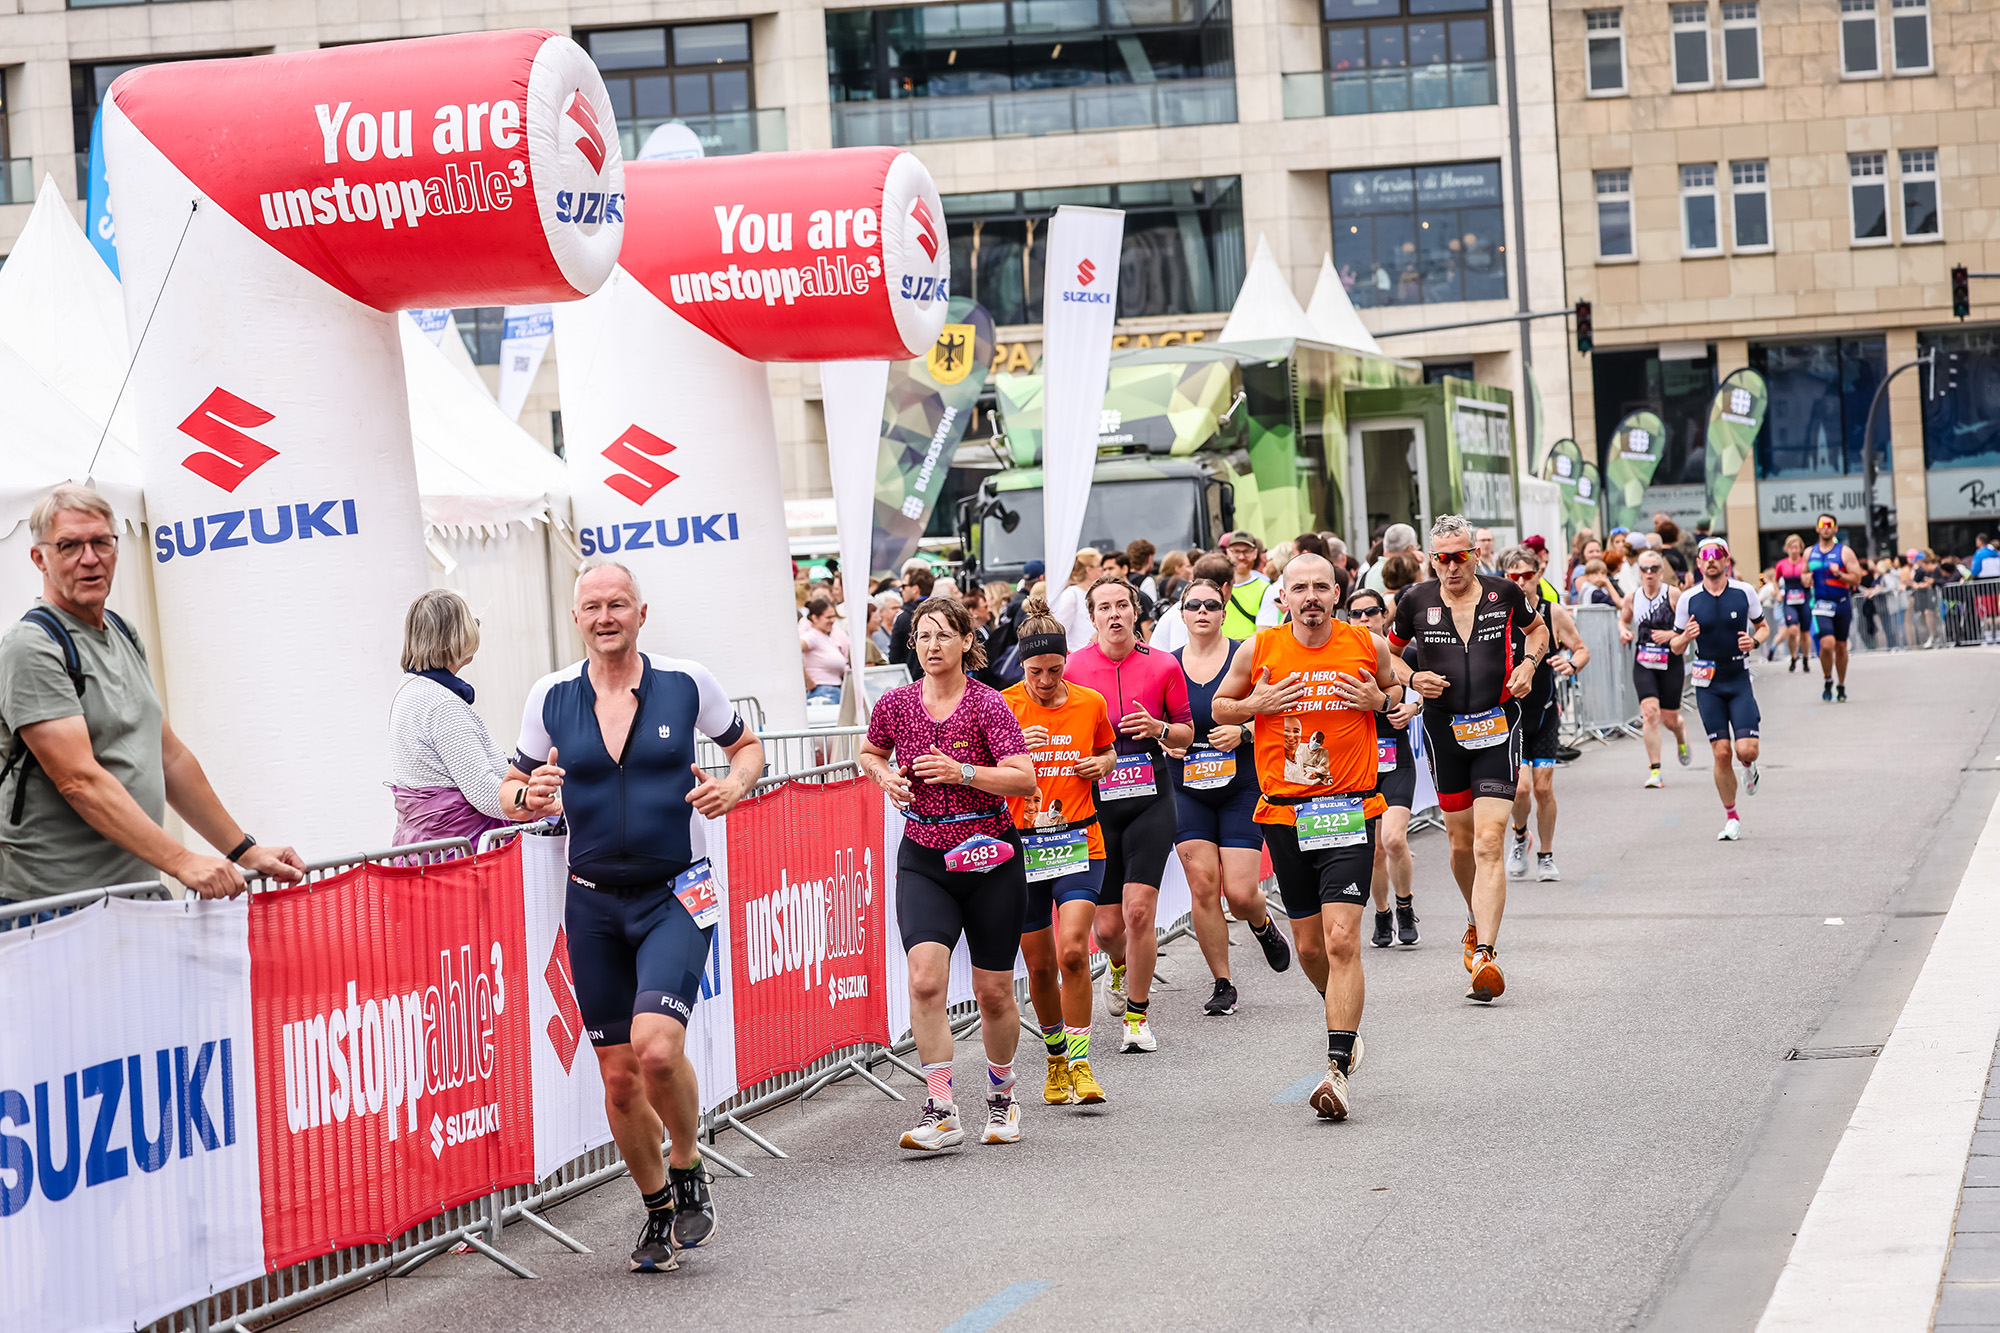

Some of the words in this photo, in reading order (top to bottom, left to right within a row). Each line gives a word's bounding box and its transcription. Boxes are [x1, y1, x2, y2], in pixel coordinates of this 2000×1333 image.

[314, 101, 413, 164] You
[433, 98, 520, 152] are
[556, 189, 626, 224] SUZUK
[714, 204, 793, 255] You
[807, 207, 879, 250] are
[1063, 291, 1110, 304] SUZUKI
[914, 405, 958, 493] BUNDESWEHR
[1772, 493, 1797, 514] JOE
[1809, 491, 1835, 511] THE
[1839, 489, 1878, 511] JUIE
[155, 499, 359, 563] SUZUKI
[580, 513, 739, 557] SUZUKI
[1424, 636, 1457, 644] ROOKIE
[1478, 631, 1502, 642] TEAM
[1302, 672, 1309, 682] A
[1311, 670, 1337, 681] HERO
[1296, 700, 1323, 712] STEM
[1470, 710, 1492, 719] SUZUKI
[1465, 719, 1495, 734] 2439
[953, 740, 968, 749] dhb
[1051, 734, 1073, 746] HERO
[1029, 751, 1054, 762] ONATE
[1055, 750, 1081, 761] BLOOD
[1037, 766, 1060, 777] STEM
[1111, 766, 1142, 782] 2612
[1195, 760, 1224, 774] 2507
[1319, 801, 1347, 809] SUZUKI
[1312, 812, 1350, 829] 2323
[1044, 833, 1071, 842] SUZUKI
[961, 845, 998, 865] 2683
[1037, 844, 1074, 862] 2322
[837, 974, 869, 1001] SUZUKI
[661, 995, 692, 1021] FUSIO
[0, 1037, 237, 1218] SUZUKI
[446, 1103, 501, 1148] SUZUKI
